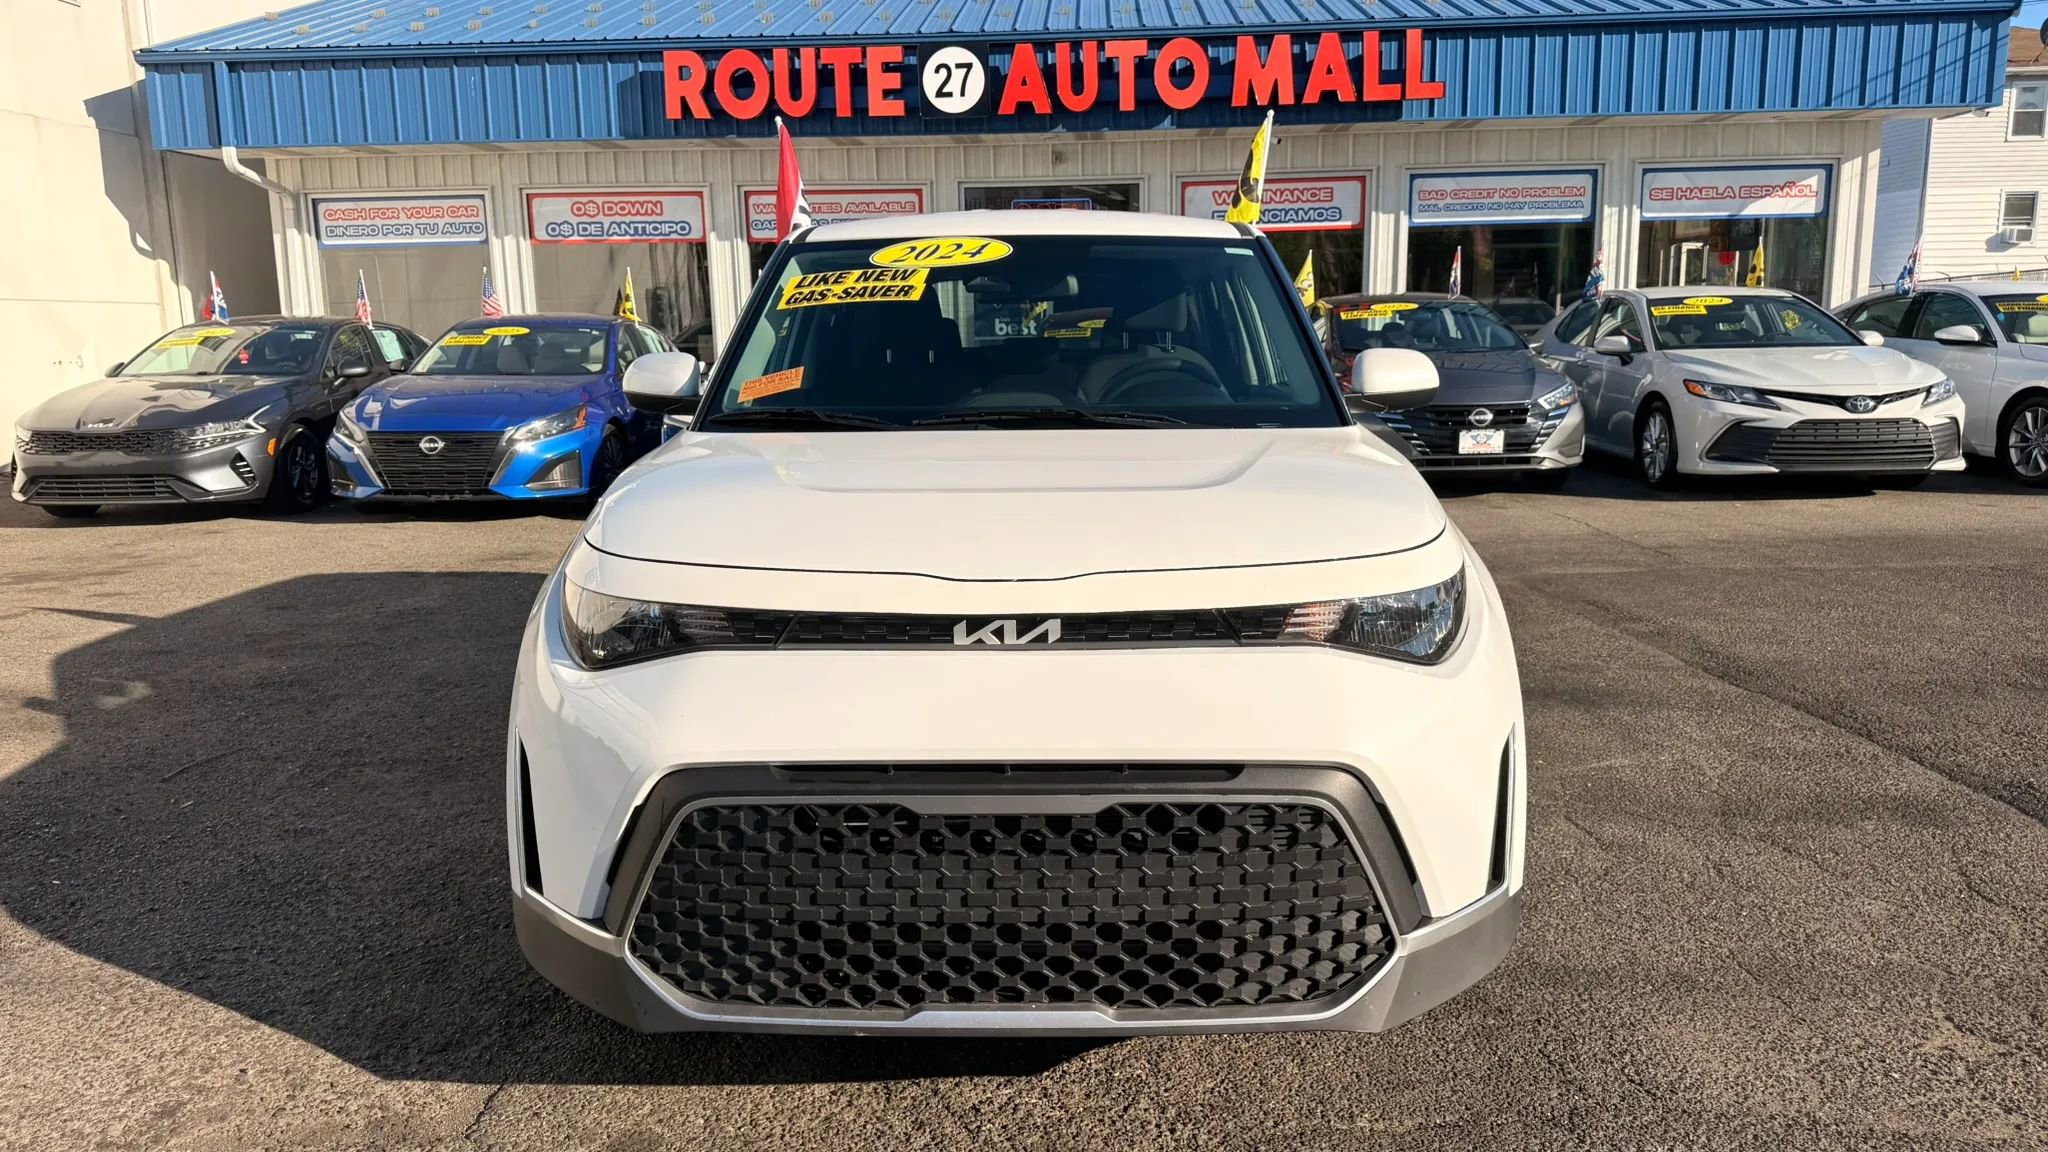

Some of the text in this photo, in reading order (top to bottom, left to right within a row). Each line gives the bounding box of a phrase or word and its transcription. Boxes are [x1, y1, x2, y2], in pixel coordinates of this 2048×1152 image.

[663, 28, 1446, 120] ROUTE 27 AUTO MALL
[1261, 187, 1333, 203] INANCE
[1418, 185, 1586, 201] BAD CREDIT NO PROBLEM
[1650, 181, 1818, 200] SE HABLA ESPAÑOL
[324, 205, 479, 221] CASH FOR YOUR CAR
[602, 200, 663, 216] DOWN
[844, 201, 916, 213] AVAILABLE
[1418, 200, 1584, 213] MAL CREDITO NO HAY PROBLEMA
[326, 221, 485, 238] DINERO POR TU AUTO
[577, 221, 604, 236] DE
[606, 220, 692, 236] ANTICIPO
[890, 241, 991, 264] 2024
[795, 269, 919, 289] LIKE NEW
[784, 284, 917, 306] GAS-SAVER
[994, 318, 1037, 336] best
[953, 618, 1061, 645] KIA
